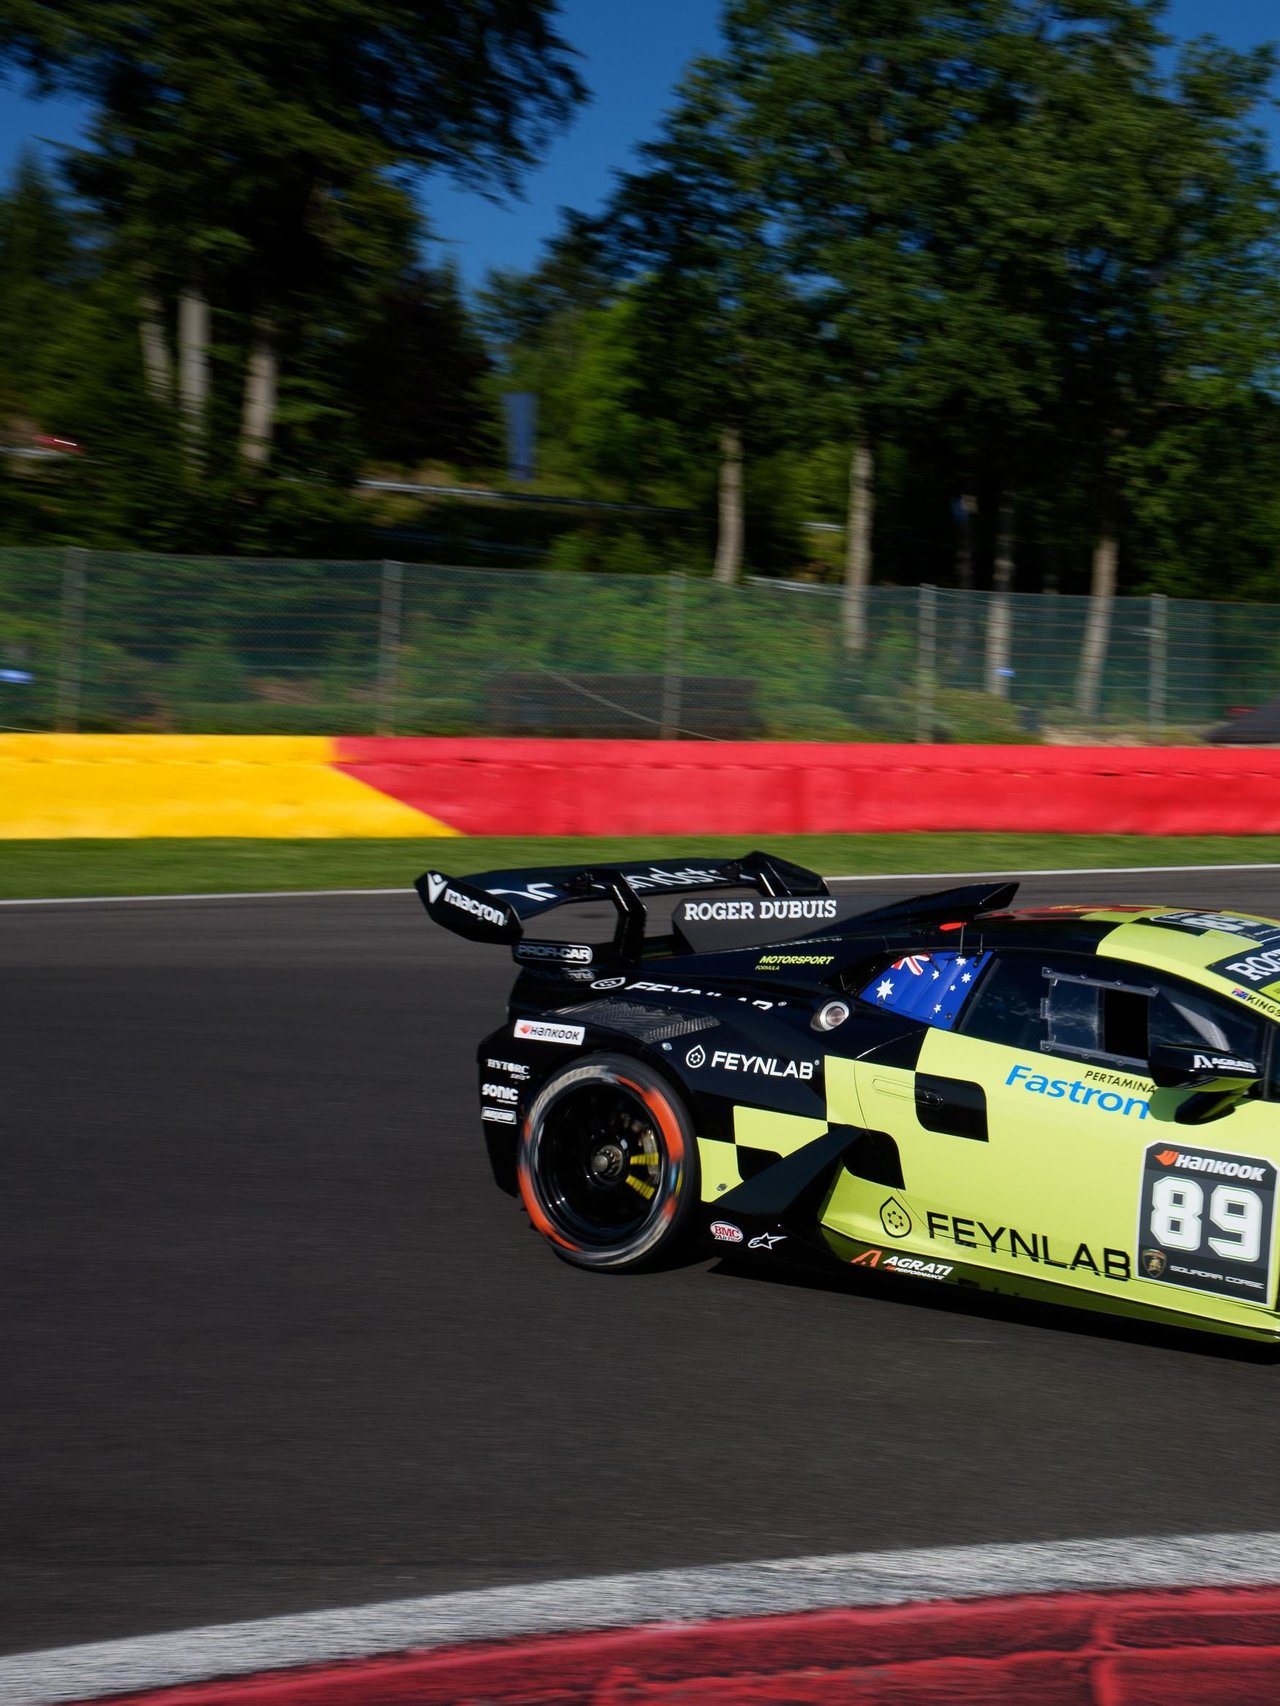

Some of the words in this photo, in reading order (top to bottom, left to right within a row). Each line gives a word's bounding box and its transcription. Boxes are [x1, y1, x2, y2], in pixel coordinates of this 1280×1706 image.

[444, 888, 505, 926] macron
[684, 902, 755, 921] ROGER
[759, 900, 837, 919] DUBUIS
[759, 955, 834, 965] MOTORSPORT
[1005, 1064, 1150, 1120] Fastron
[1084, 1070, 1156, 1094] PERTAMINA
[1150, 1176, 1263, 1263] 89
[714, 1225, 739, 1239] BMC
[926, 1211, 1131, 1282] FEYNLAB
[882, 1255, 954, 1276] AGRATI
